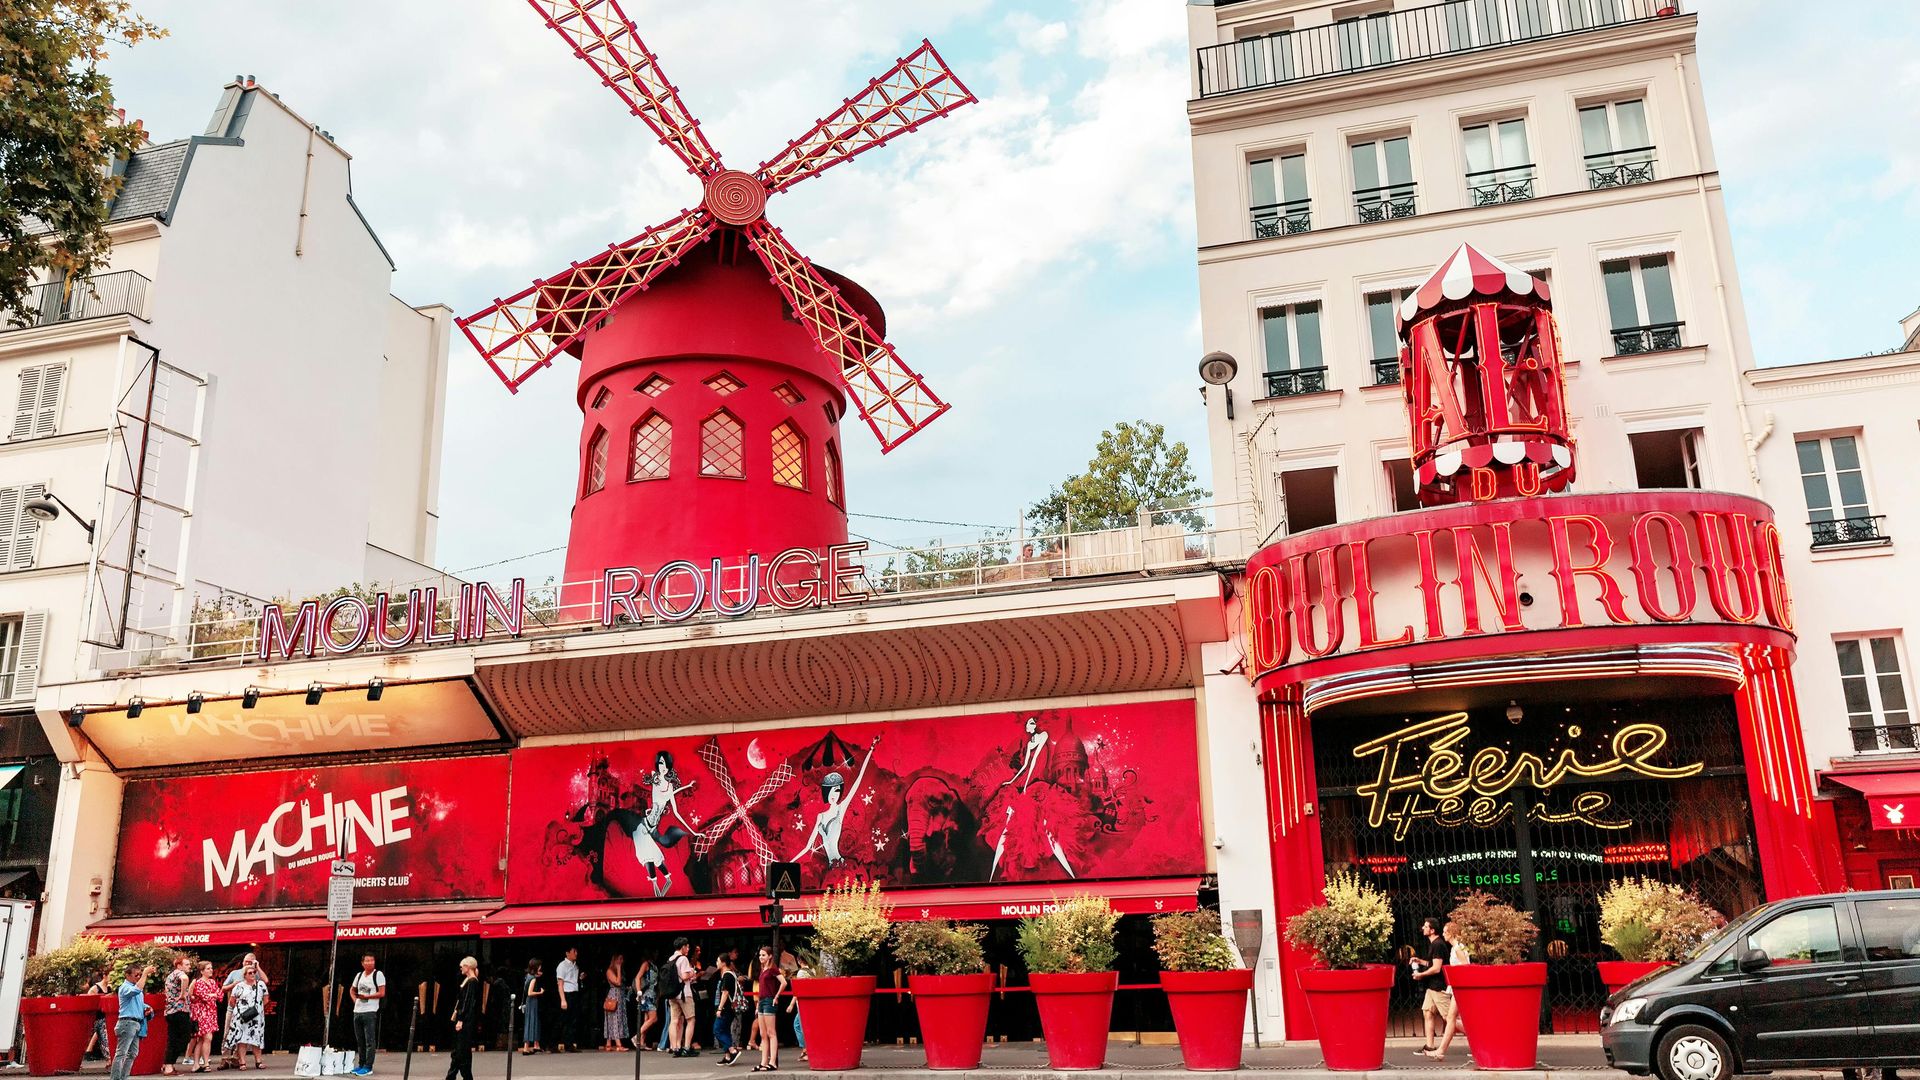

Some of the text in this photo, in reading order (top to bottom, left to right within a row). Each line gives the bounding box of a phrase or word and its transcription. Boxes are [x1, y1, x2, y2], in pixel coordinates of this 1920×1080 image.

[1473, 464, 1541, 501] DU
[259, 541, 869, 662] MOULIN ROUGE
[1245, 522, 1529, 680] OULIN
[202, 785, 412, 892] MACHINE
[297, 856, 318, 867] MOULIN
[318, 851, 336, 863] ROUGE
[388, 876, 410, 887] CLUB
[1450, 874, 1470, 884] LES
[1001, 904, 1040, 916] MOULIN
[336, 926, 397, 937] MOULIN ROUGE
[575, 920, 643, 932] MOULIN ROUGE
[154, 934, 210, 944] MOULIN ROUGE
